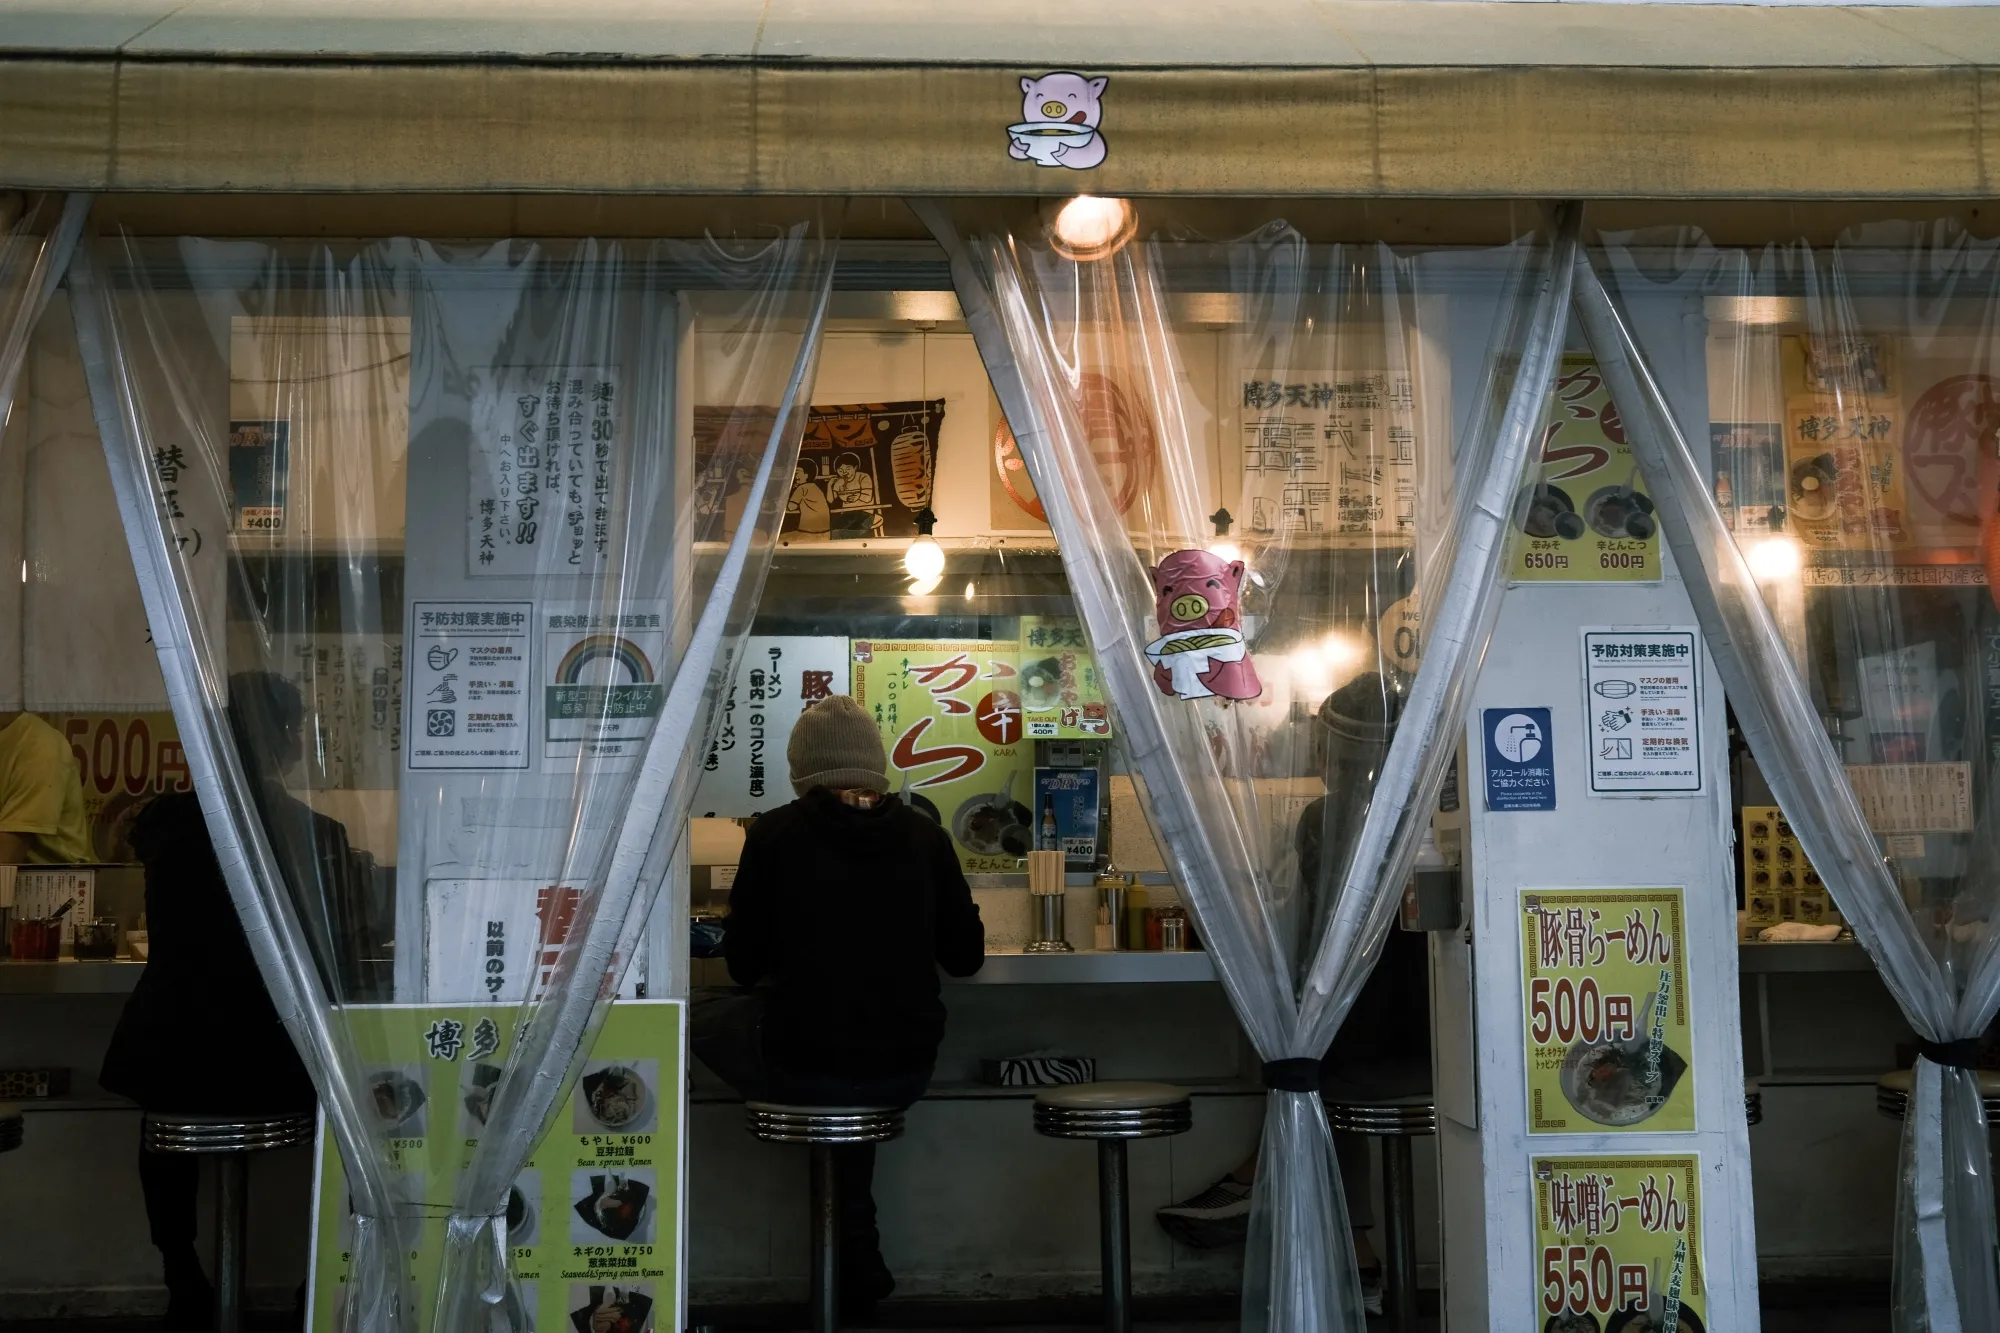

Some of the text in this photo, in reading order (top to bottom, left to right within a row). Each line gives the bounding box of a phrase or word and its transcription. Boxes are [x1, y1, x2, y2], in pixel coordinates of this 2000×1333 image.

[1243, 381, 1334, 410] 博多天神
[1797, 414, 1891, 441] 博多天神
[499, 434, 512, 546] 中へお入り下さい。
[247, 517, 281, 529] ¥400
[480, 499, 496, 566] 博多天神
[1531, 540, 1561, 550] 辛みそ
[1596, 540, 1647, 550] 辛とんこつ
[1524, 553, 1568, 569] 650円
[1600, 553, 1645, 569] 600円
[420, 612, 525, 626] 予防対策実施中
[1027, 626, 1086, 648] 博多天
[1591, 643, 1689, 658] 予防対策実施中
[768, 647, 783, 699] ラーメン
[749, 668, 765, 798] (都内一のコクと濃度)
[993, 748, 1018, 757] KARA
[1491, 768, 1550, 777] アルコール消毒に
[1492, 778, 1550, 788] ご協力ください
[1066, 846, 1093, 855] ¥400
[1539, 907, 1672, 968] 豚骨らーめん
[1531, 976, 1636, 1045] 500円
[1645, 970, 1673, 1084] 圧力釜出し特製スープ
[580, 1135, 651, 1146] もやし ¥600
[577, 1157, 653, 1169] Bean sprout Ramen
[1552, 1174, 1687, 1236] 味噌らーめん
[1560, 1237, 1596, 1246] Mi So
[573, 1245, 653, 1256] ネギのり ¥750
[620, 1268, 639, 1278] onion
[641, 1267, 664, 1278] Ramen
[1543, 1245, 1650, 1316] 550円
